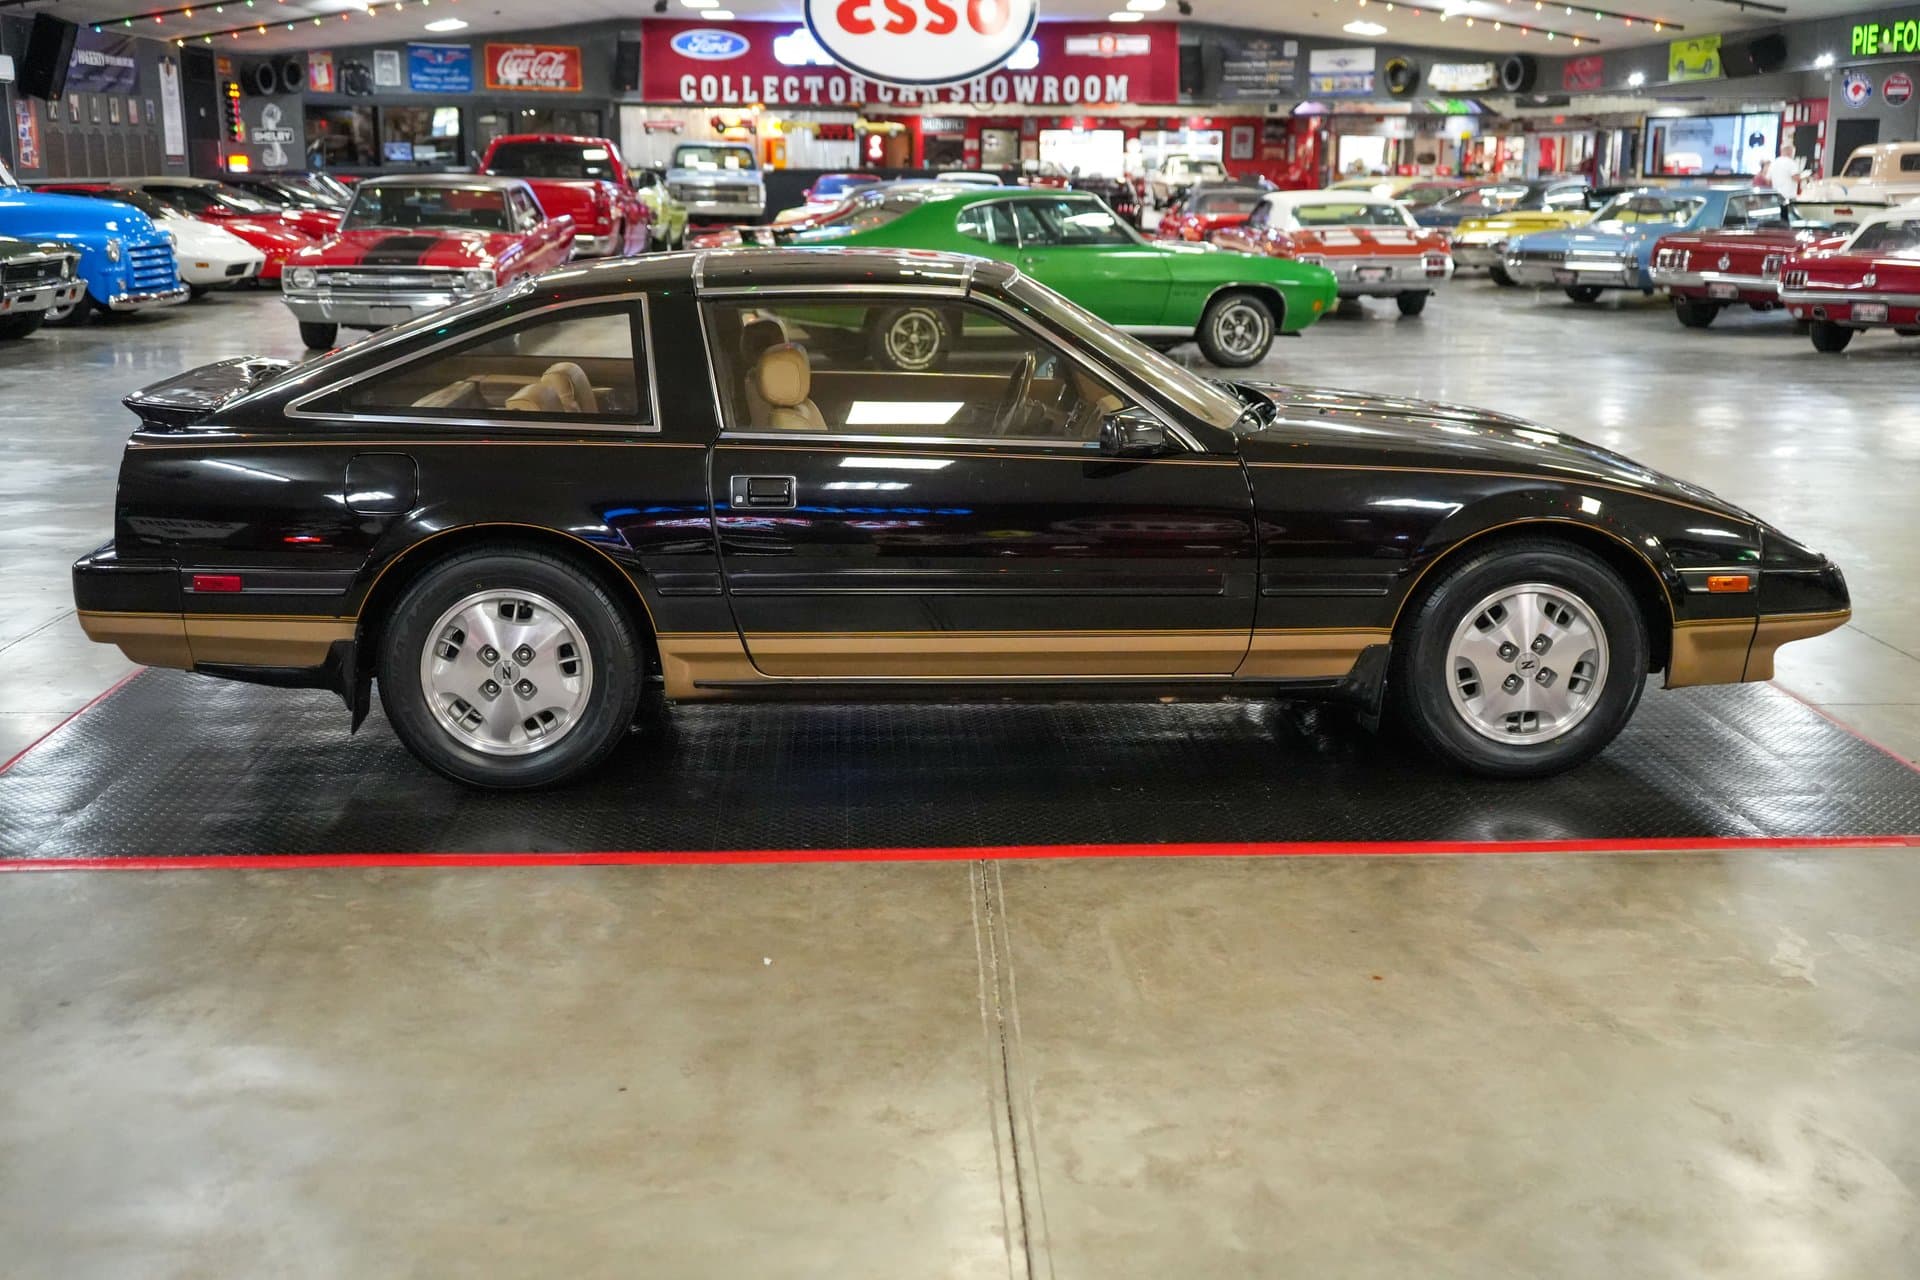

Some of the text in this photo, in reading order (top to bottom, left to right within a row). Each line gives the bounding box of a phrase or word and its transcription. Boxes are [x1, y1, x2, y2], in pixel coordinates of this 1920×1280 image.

[687, 35, 733, 53] Ford
[1852, 20, 1920, 55] PIE FO
[680, 74, 1128, 103] COLLECTOR CAR SHOWROOM
[254, 131, 292, 142] SHELBY
